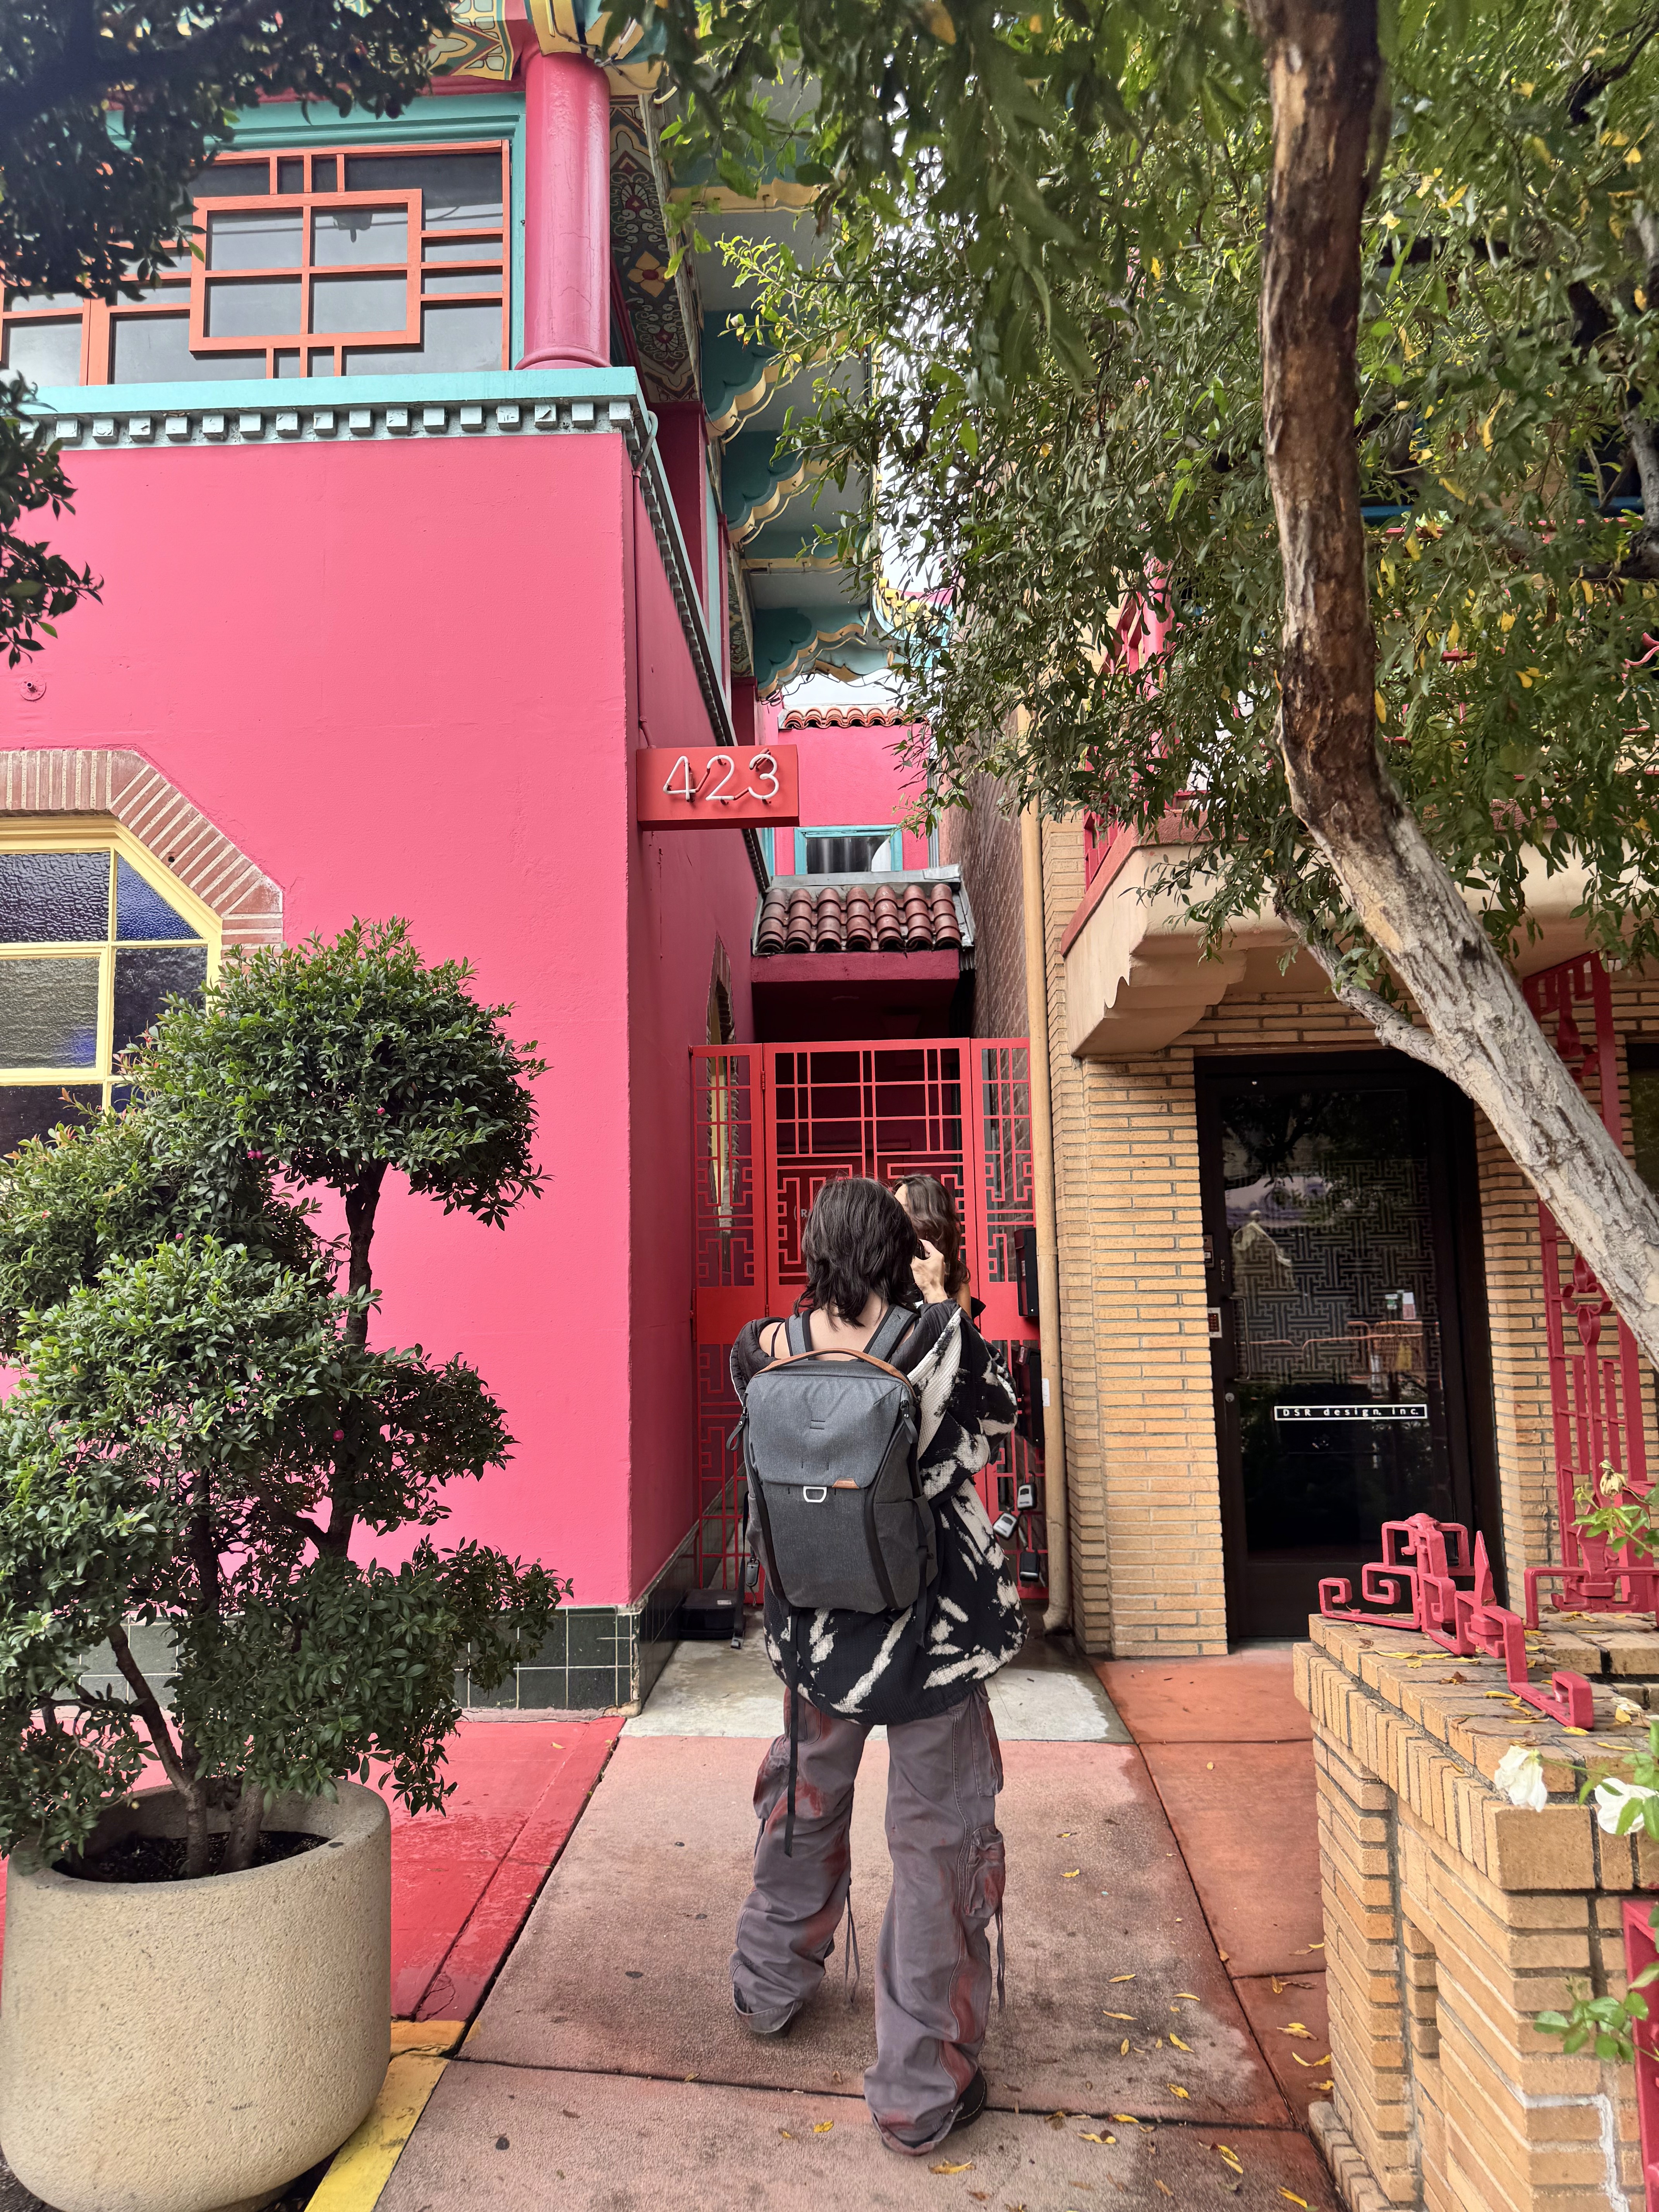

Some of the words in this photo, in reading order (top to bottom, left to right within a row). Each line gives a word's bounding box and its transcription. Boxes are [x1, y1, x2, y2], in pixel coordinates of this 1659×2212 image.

[663, 753, 779, 802] 423
[1283, 1408, 1312, 1417] DSR
[1392, 1407, 1419, 1415] inc.
